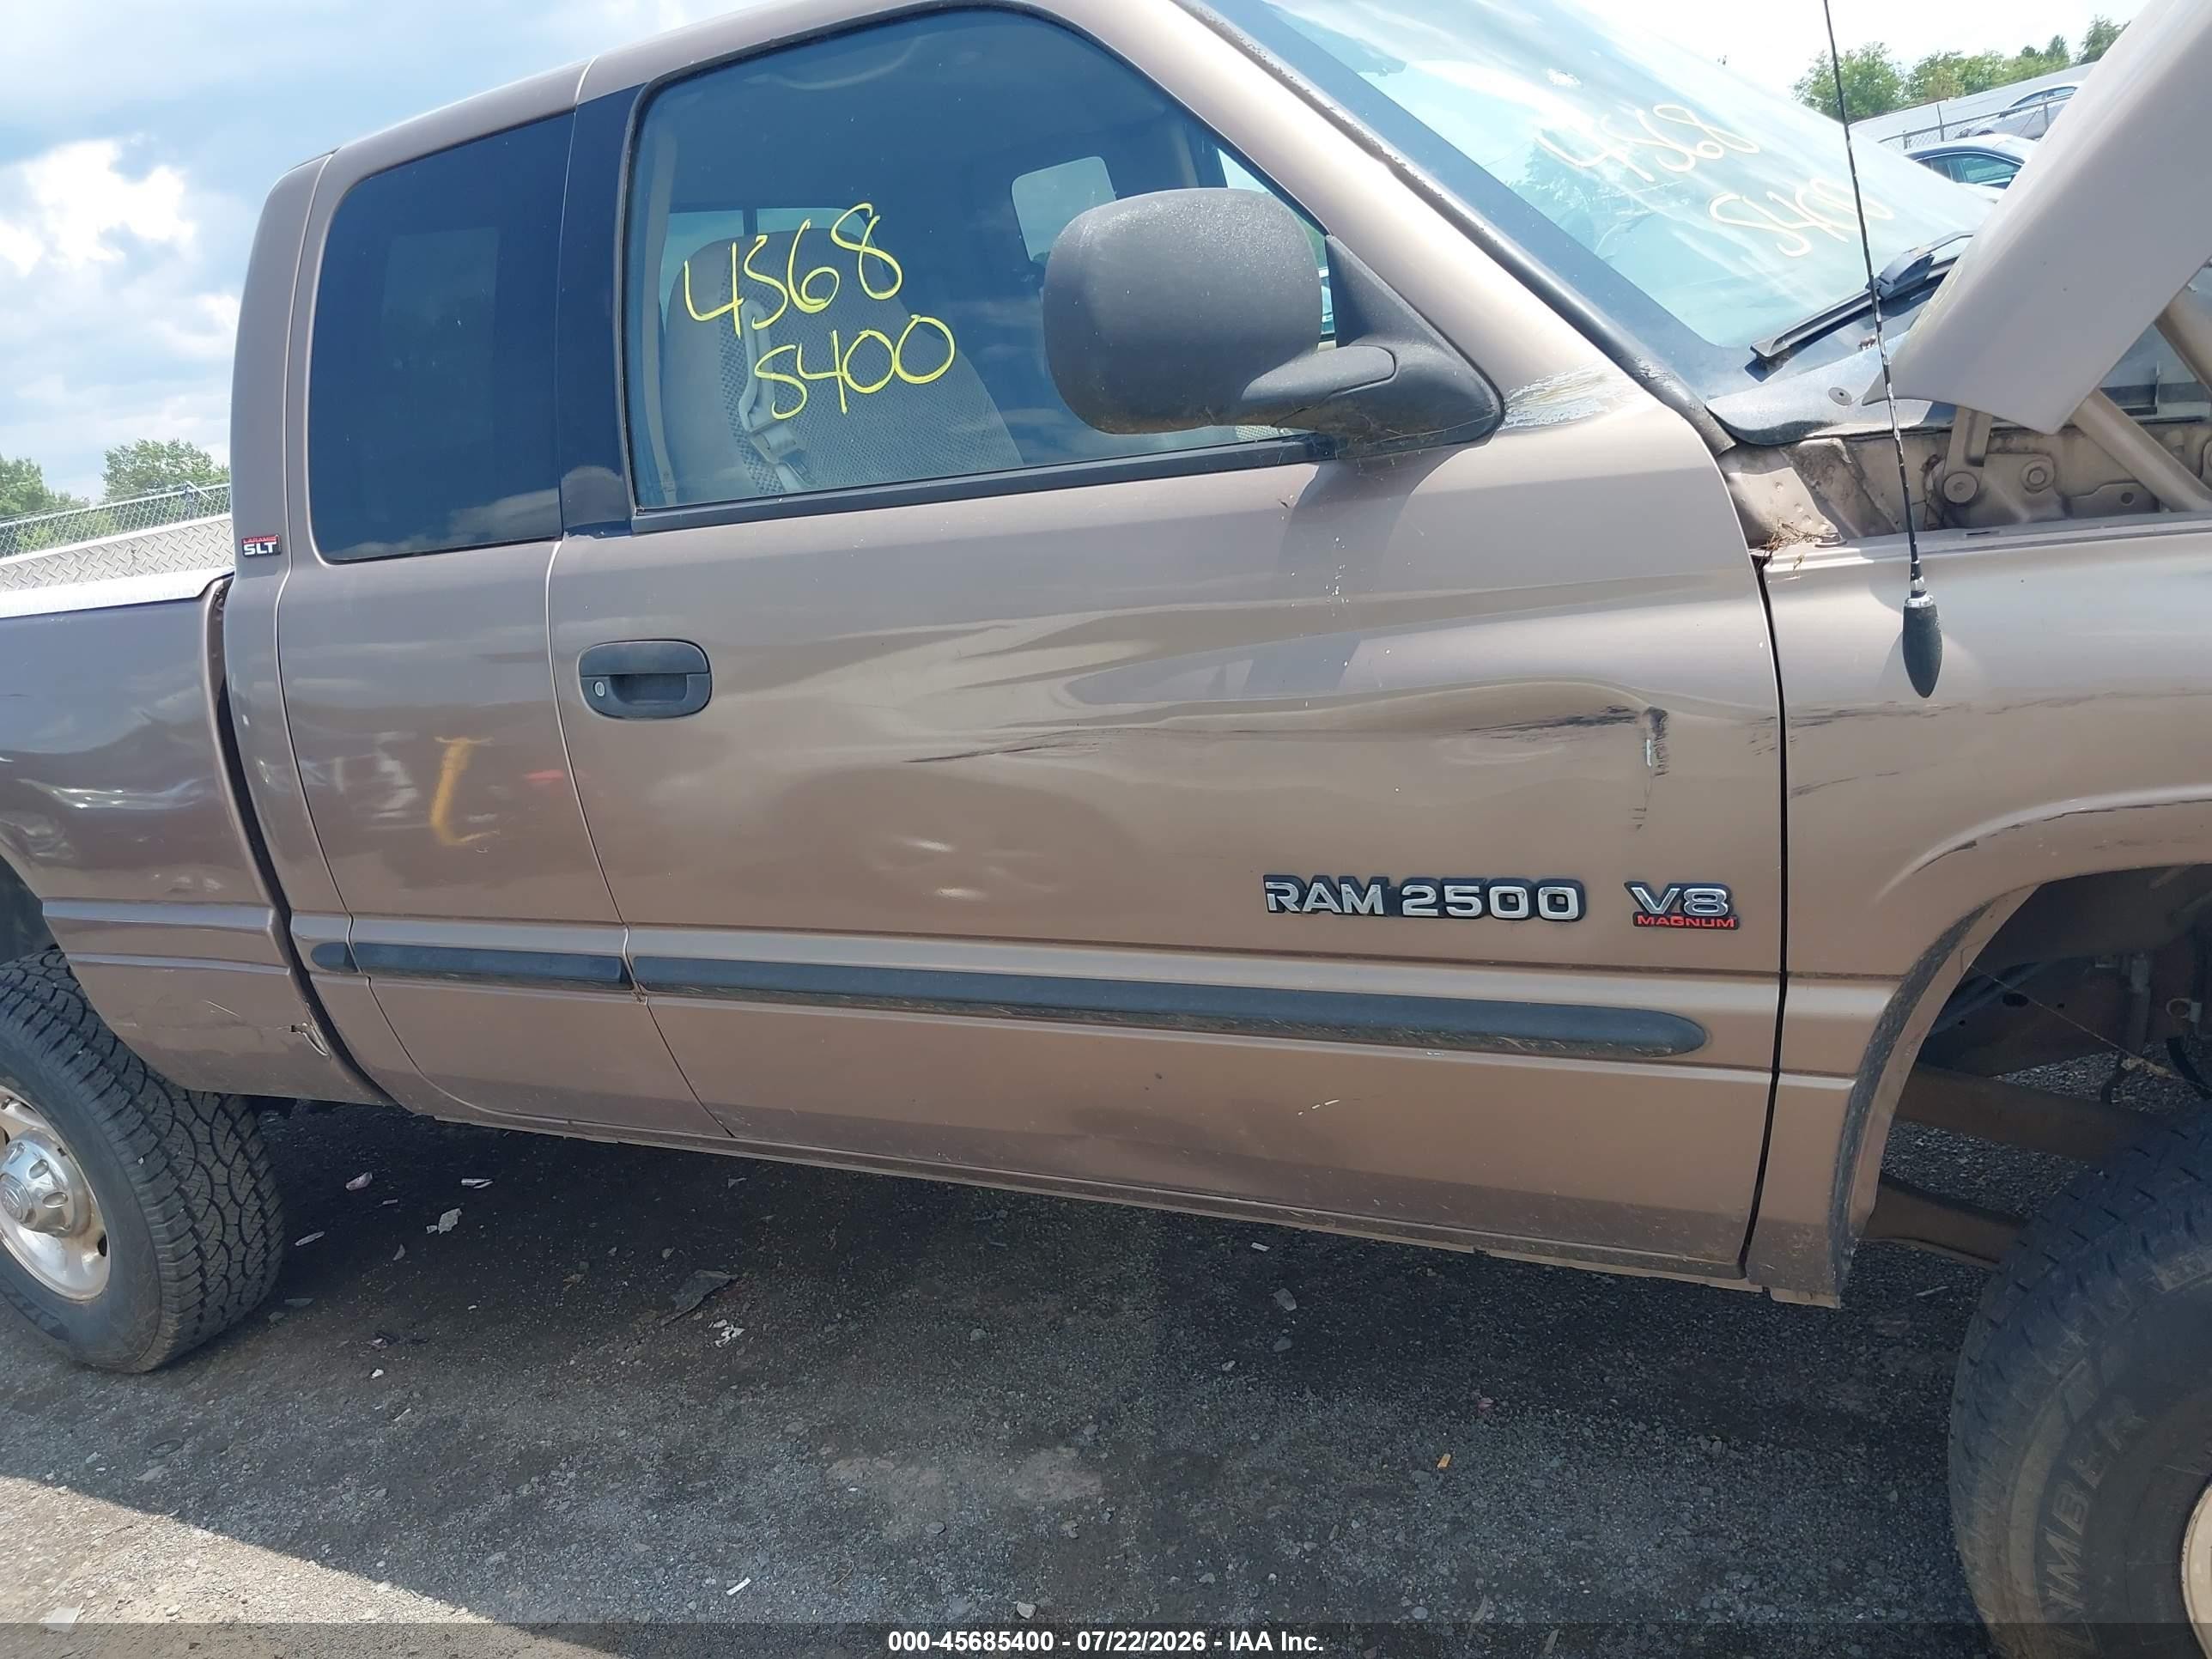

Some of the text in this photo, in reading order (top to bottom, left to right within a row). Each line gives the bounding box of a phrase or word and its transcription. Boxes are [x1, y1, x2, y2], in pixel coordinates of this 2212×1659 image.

[684, 203, 902, 339] 4568
[754, 314, 956, 419] 5400
[243, 541, 276, 556] SLT
[1264, 876, 1586, 921] RAM 2500
[1626, 884, 1731, 917] V8
[1636, 915, 1735, 928] MAGNUM
